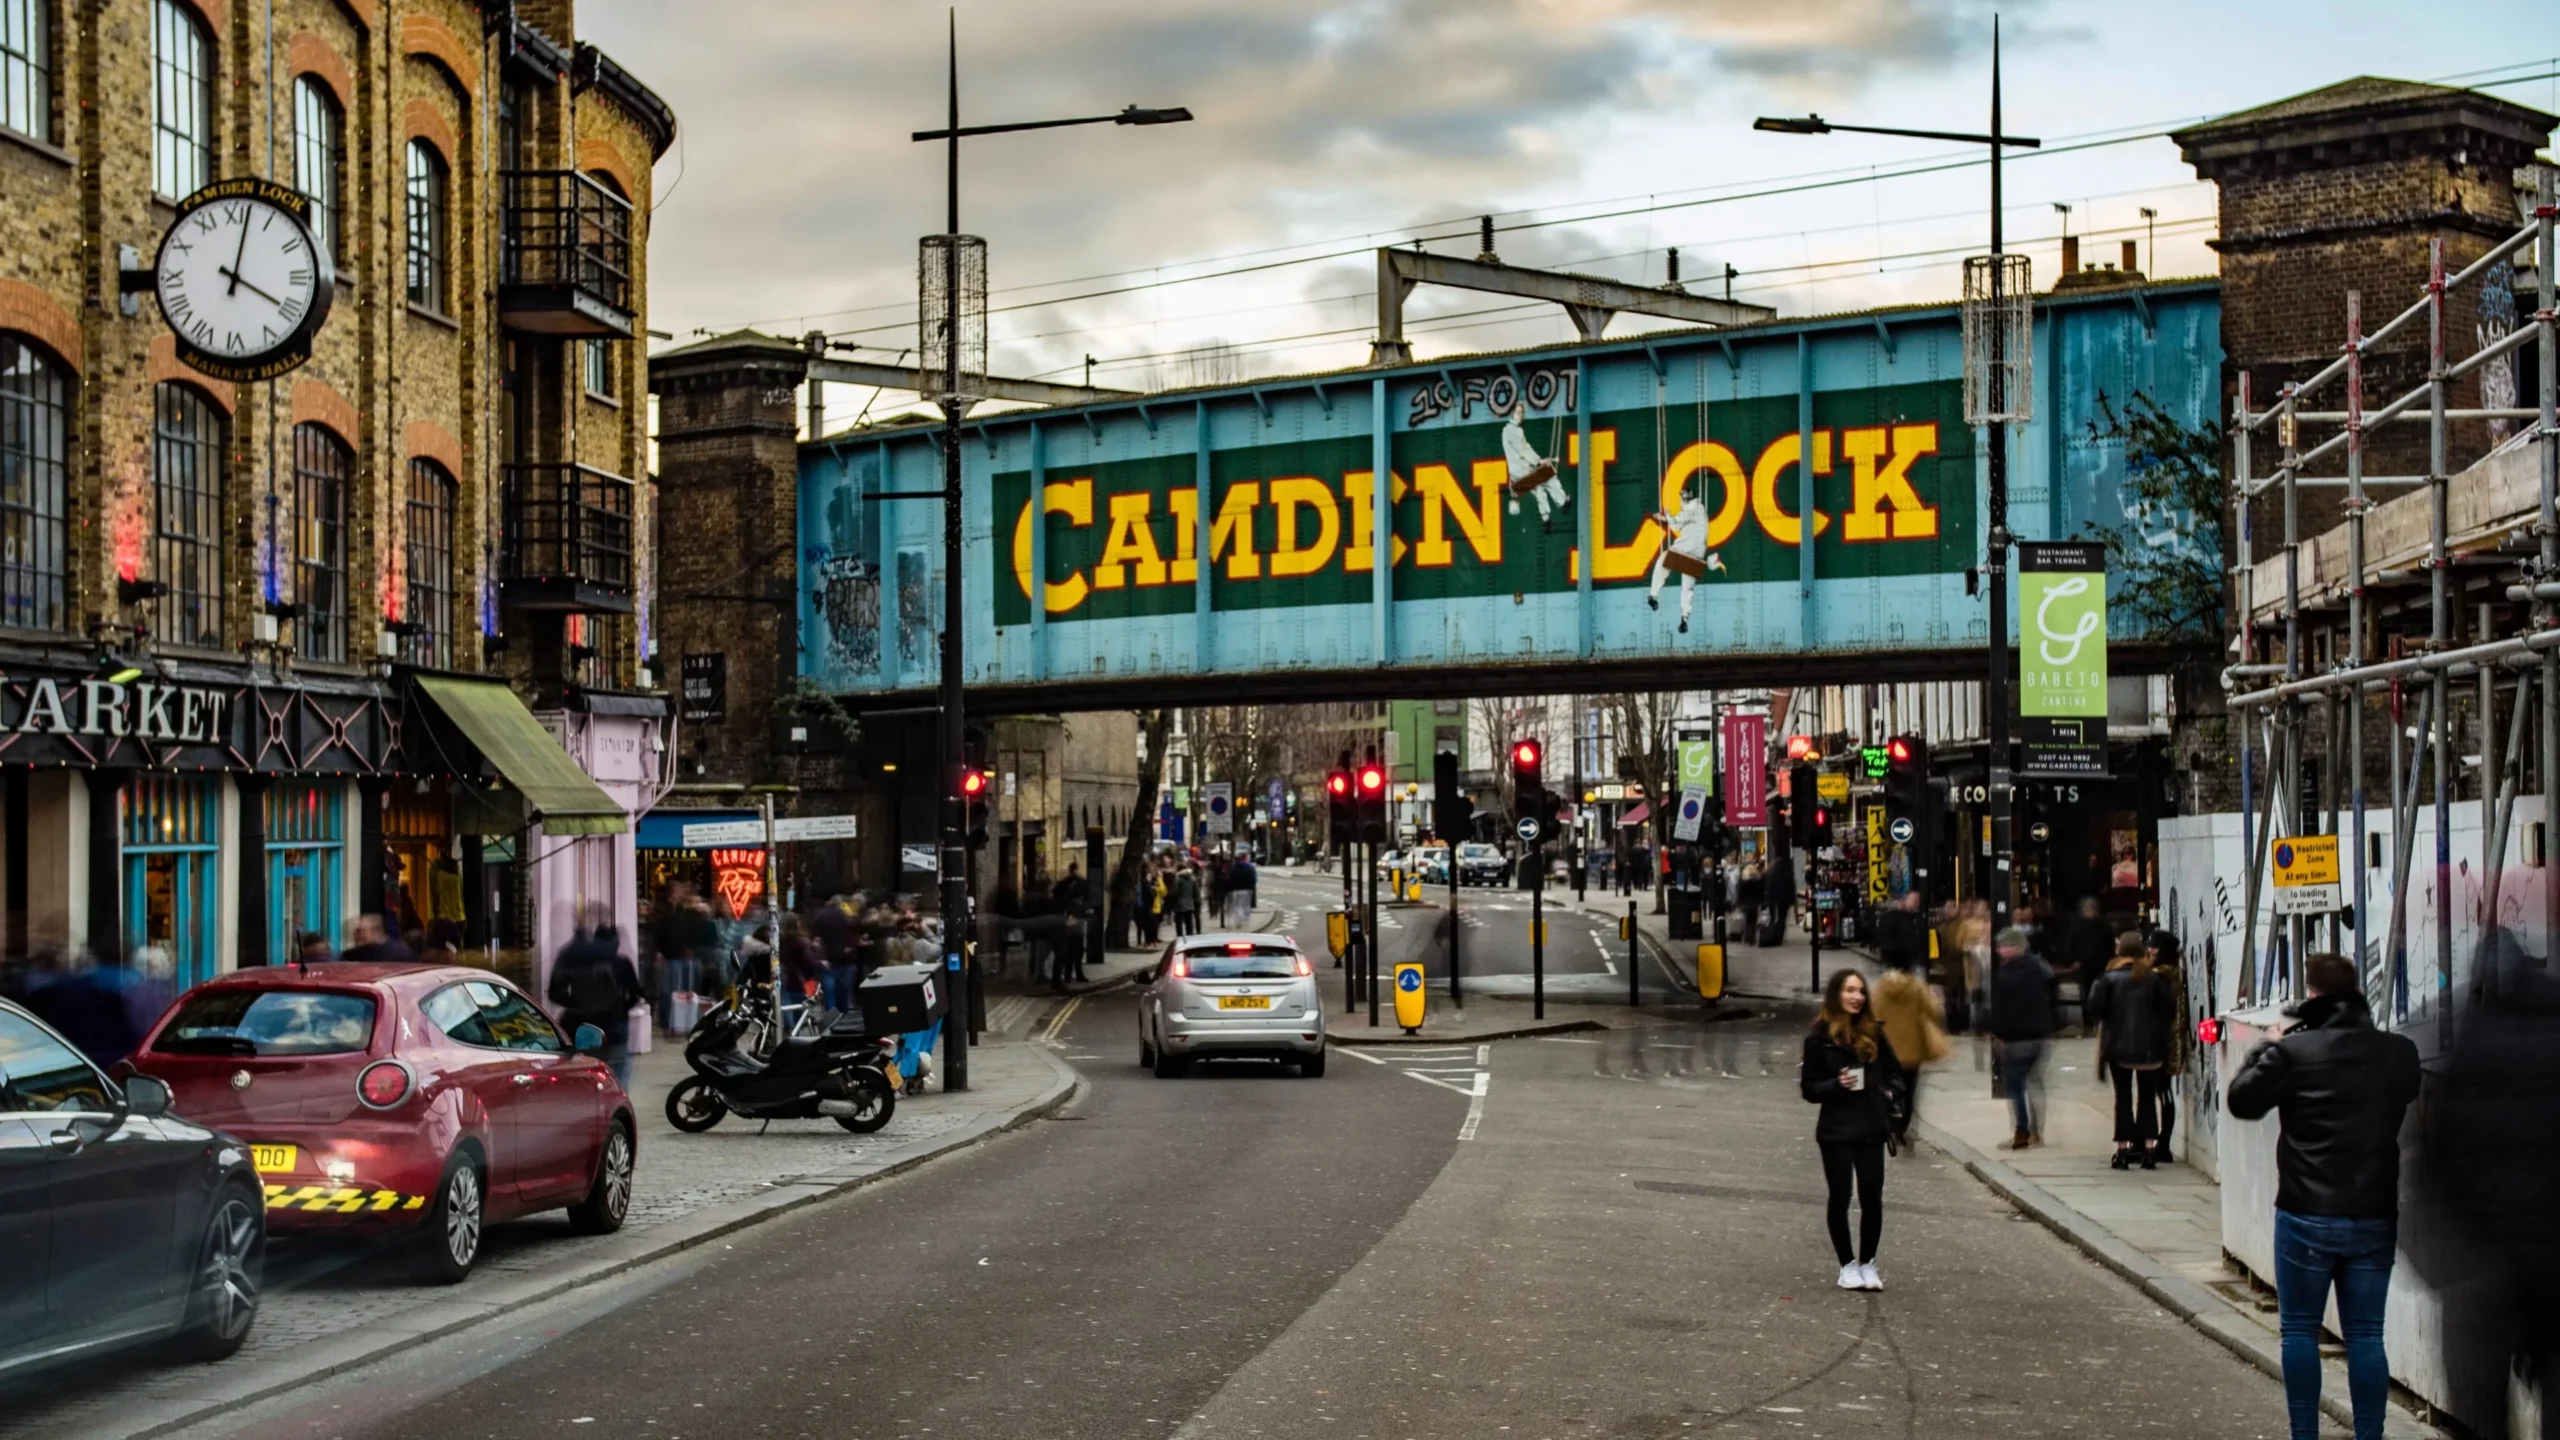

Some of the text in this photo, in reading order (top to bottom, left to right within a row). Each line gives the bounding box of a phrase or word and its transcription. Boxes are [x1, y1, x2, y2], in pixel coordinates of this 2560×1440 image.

[183, 180, 306, 213] CAMDEN LOCK
[185, 350, 304, 380] MARKET HALL
[1012, 419, 1940, 614] CAMDEN LOCK
[2054, 556, 2087, 566] TERRACE
[2027, 671, 2100, 688] GABETO
[2041, 695, 2087, 707] CANTINA
[2059, 727, 2077, 737] MIN
[658, 848, 698, 859] PIZZA
[2296, 842, 2335, 854] Restricted
[711, 848, 766, 867] CAMDEN
[2306, 854, 2325, 864] Zone
[2285, 872, 2294, 881] At
[2296, 872, 2308, 882] any
[2299, 888, 2327, 899] loading
[2287, 902, 2294, 910] at
[2312, 899, 2329, 908] time
[254, 1148, 286, 1167] DO
